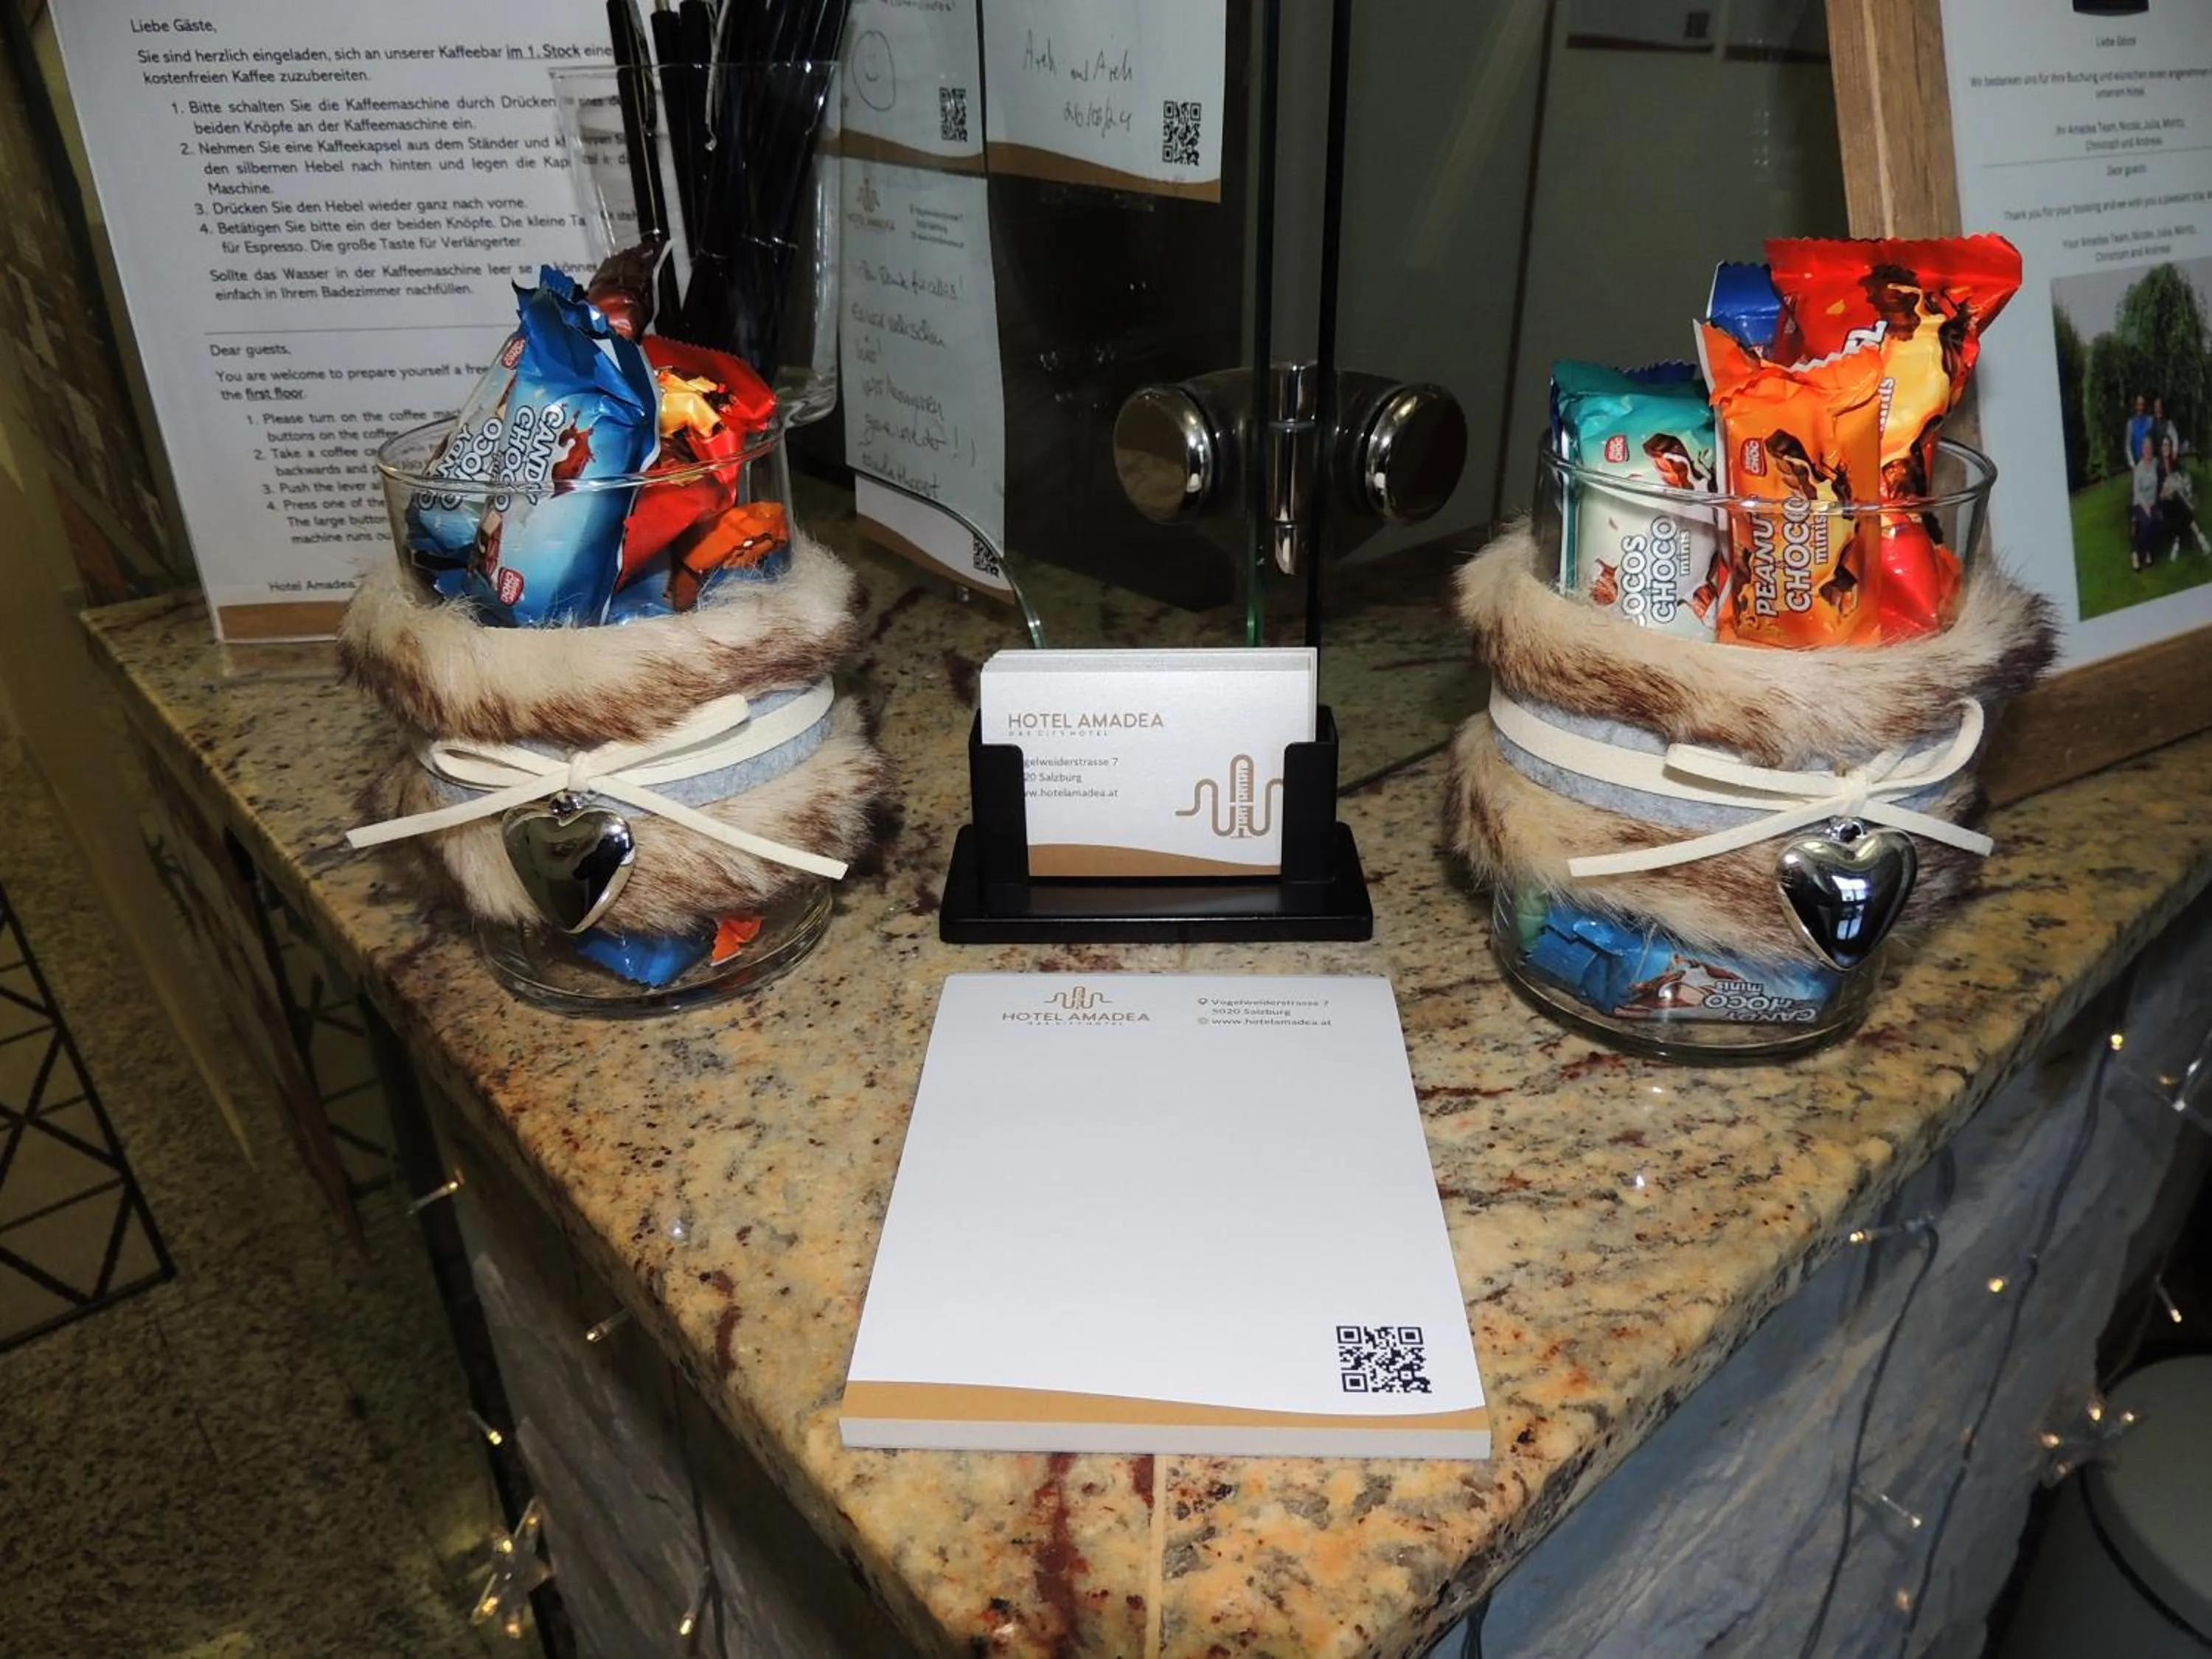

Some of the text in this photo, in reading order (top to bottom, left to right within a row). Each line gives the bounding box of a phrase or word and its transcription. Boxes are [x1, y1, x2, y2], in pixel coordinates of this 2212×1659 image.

[131, 19, 216, 32] Liebe Gäste,
[138, 44, 580, 65] Sie sind herzlich eingeladen, sich an unserer Kaffeebar im Stock
[143, 69, 367, 84] kostenfreien Kaffee zuzubereiten.
[189, 101, 222, 114] Bitte
[229, 100, 285, 113] schalten
[291, 99, 311, 112] Sie
[319, 99, 339, 111] die
[346, 97, 450, 111] Kaffeemaschine
[456, 97, 495, 109] durch
[501, 95, 556, 108] Drücken
[194, 119, 448, 135] beiden Knöpfe an der Kaffeemaschine
[198, 136, 549, 154] Nehmen Sie eine Kaffeekapsel aus dem Ständer und
[204, 163, 229, 174] den
[236, 162, 297, 174] silbernen
[305, 161, 344, 173] Hebel
[352, 160, 382, 172] nach
[389, 159, 431, 171] hinten
[439, 159, 465, 170] und
[472, 158, 507, 173] legen
[516, 157, 535, 168] die
[543, 156, 571, 169] Kap
[208, 183, 272, 195] Maschine.
[212, 198, 524, 215] Drücken Sie den Hebel wieder ganz nach vorne.
[217, 222, 281, 236] Betätigen
[285, 220, 305, 232] Sie
[310, 221, 341, 232] bitte
[346, 223, 365, 232] ein
[370, 220, 391, 231] der
[397, 219, 442, 230] beiden
[501, 216, 523, 228] Die
[527, 216, 565, 226] kleine
[222, 242, 240, 253] für
[244, 241, 303, 255] Espresso.
[310, 240, 333, 251] Die
[337, 238, 376, 254] große
[380, 238, 415, 249] Taste
[419, 237, 437, 248] für
[209, 264, 511, 282] Sollte das Wasser in der Kaffeemaschine leer
[215, 284, 472, 301] einfach Ihrem Badezimmer nachfüllen.
[210, 344, 291, 358] Dear guests,
[215, 371, 242, 382] You
[247, 372, 266, 380] are
[271, 369, 325, 380] welcome
[329, 369, 343, 379] to
[347, 369, 396, 380] prepare
[400, 364, 450, 380] yourself
[220, 389, 271, 401] the first
[262, 409, 426, 424] Please turn on the coffee
[267, 432, 315, 442] buttons
[319, 432, 335, 440] on
[338, 430, 358, 439] the
[271, 447, 358, 459] Take coffee
[275, 465, 367, 476] backwards and
[279, 482, 366, 493] Push the lever
[283, 500, 345, 509] Press one
[287, 517, 345, 528] The large
[291, 533, 371, 543] machine runs
[1783, 495, 1812, 613] CHOCO
[1650, 517, 1677, 623] CHOCO
[1753, 513, 1778, 617] PEANU
[1008, 713, 1164, 728] HOTEL AMADEA
[1024, 757, 1119, 769] gelweiderstrasse 7
[1039, 773, 1082, 784] Salzburg
[1024, 787, 1119, 798] w.hotelamadea.at
[1003, 1012, 1150, 1021] HOTEL AMADEA
[1245, 1008, 1290, 1016] Salzburg
